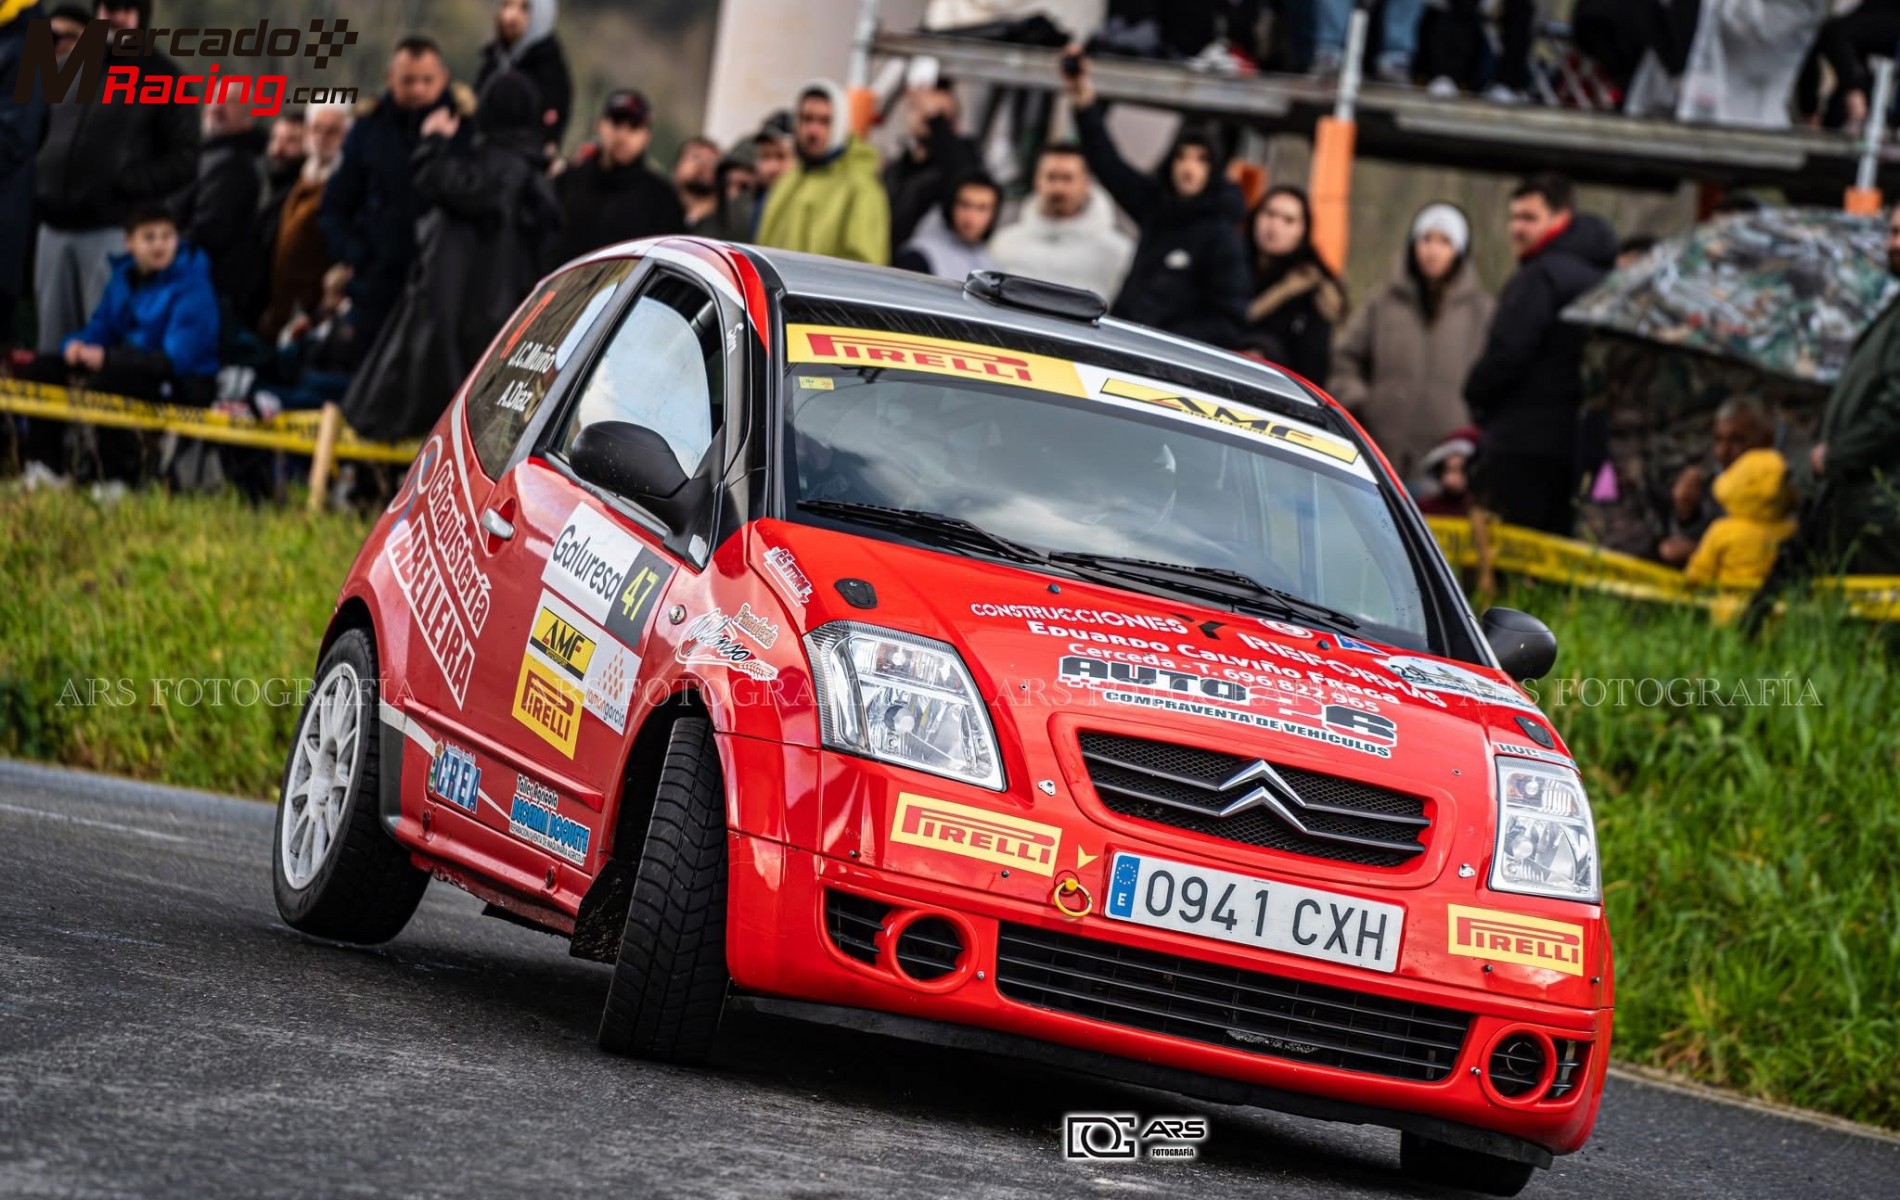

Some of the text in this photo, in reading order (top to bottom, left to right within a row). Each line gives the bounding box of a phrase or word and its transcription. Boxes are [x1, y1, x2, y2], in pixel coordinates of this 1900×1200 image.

[806, 333, 1032, 382] PIRELLI
[1150, 396, 1314, 439] AMF
[553, 524, 624, 602] Galuresa
[621, 566, 660, 621] 47
[387, 512, 475, 711] ABELLEIRA
[542, 618, 585, 662] AMF
[971, 603, 1188, 635] CONSTRUCCIONES
[1237, 632, 1448, 708] REFORMAS
[1068, 643, 1176, 669] Cerceda
[1223, 669, 1272, 687] 696
[1278, 679, 1328, 700] 822
[1331, 691, 1380, 713] 965
[521, 669, 575, 742] PIRELLI
[1105, 691, 1390, 757] COMPRAVENTA DE VEHÍCULOS
[901, 804, 1056, 864] PIRELLI
[1117, 869, 1389, 961] E 0941 CXH
[1456, 915, 1581, 964] PIRELLI
